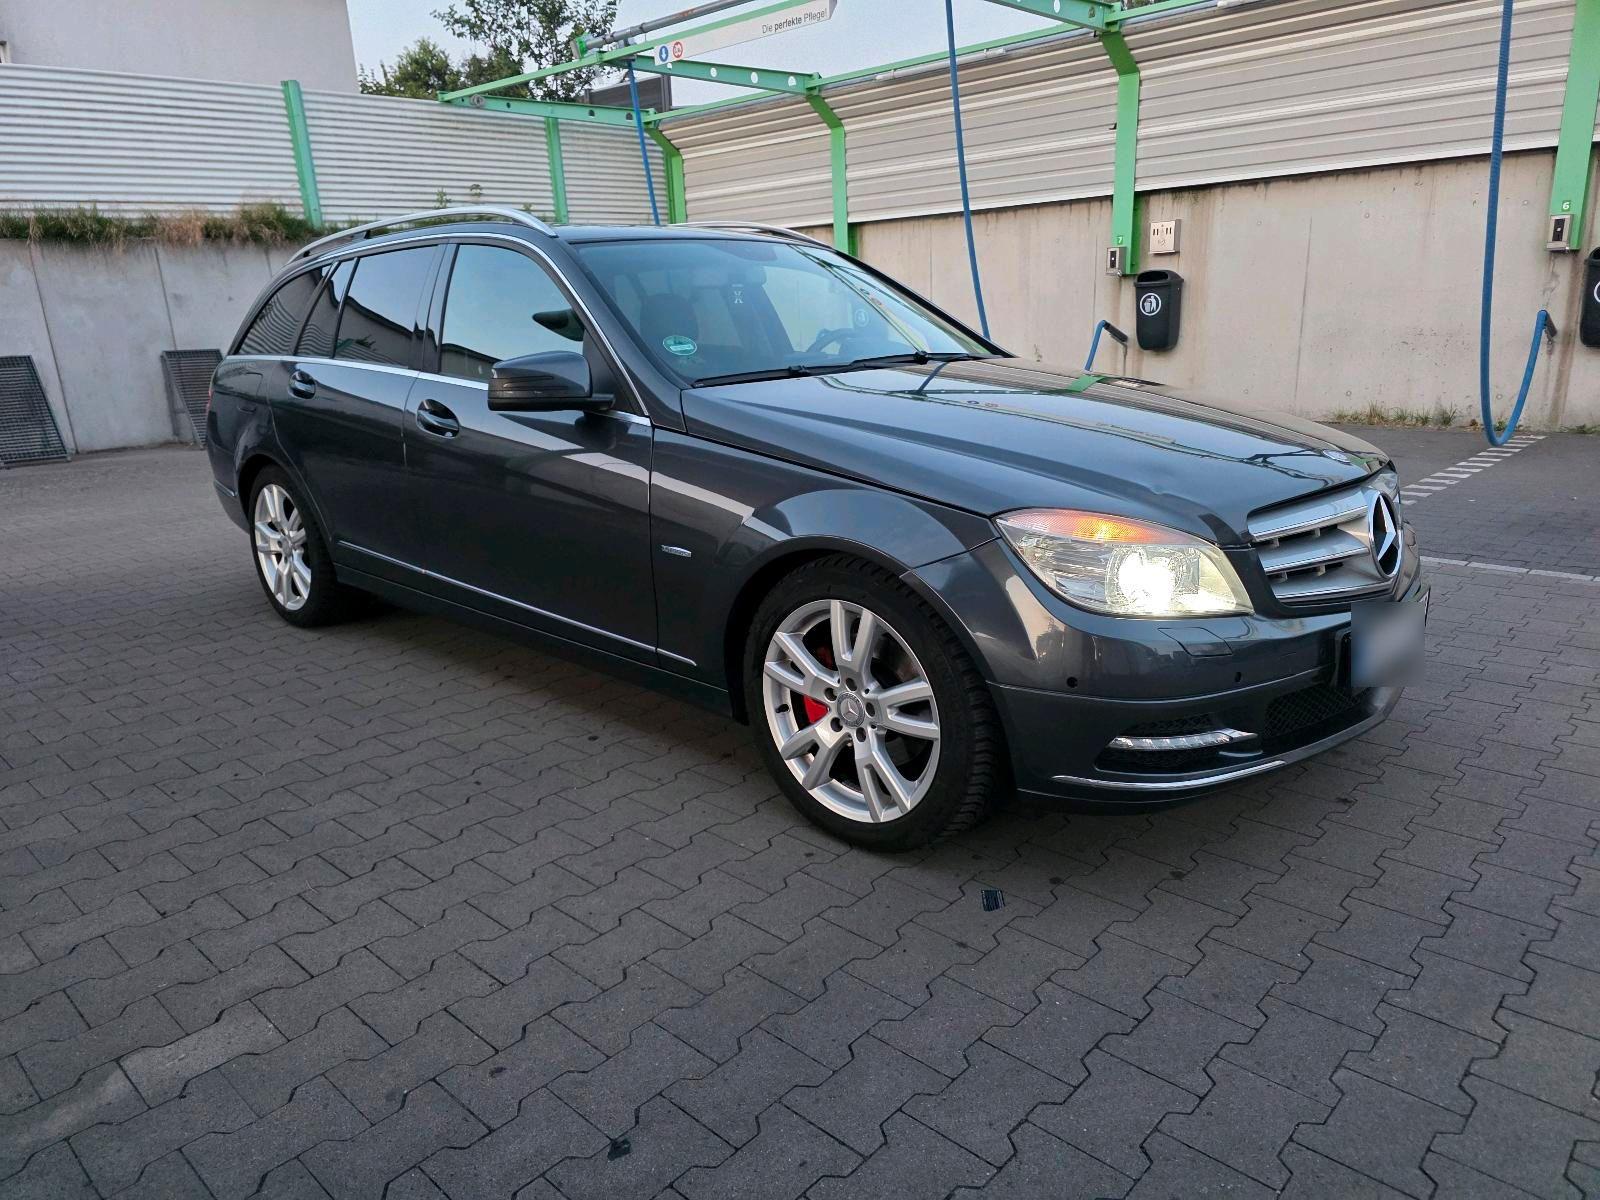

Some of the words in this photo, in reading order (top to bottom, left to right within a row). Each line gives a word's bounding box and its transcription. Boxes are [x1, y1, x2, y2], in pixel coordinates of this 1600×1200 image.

[761, 23, 773, 34] Die
[774, 16, 802, 32] perfekte
[803, 8, 827, 23] Pflege!
[1562, 201, 1570, 210] 6
